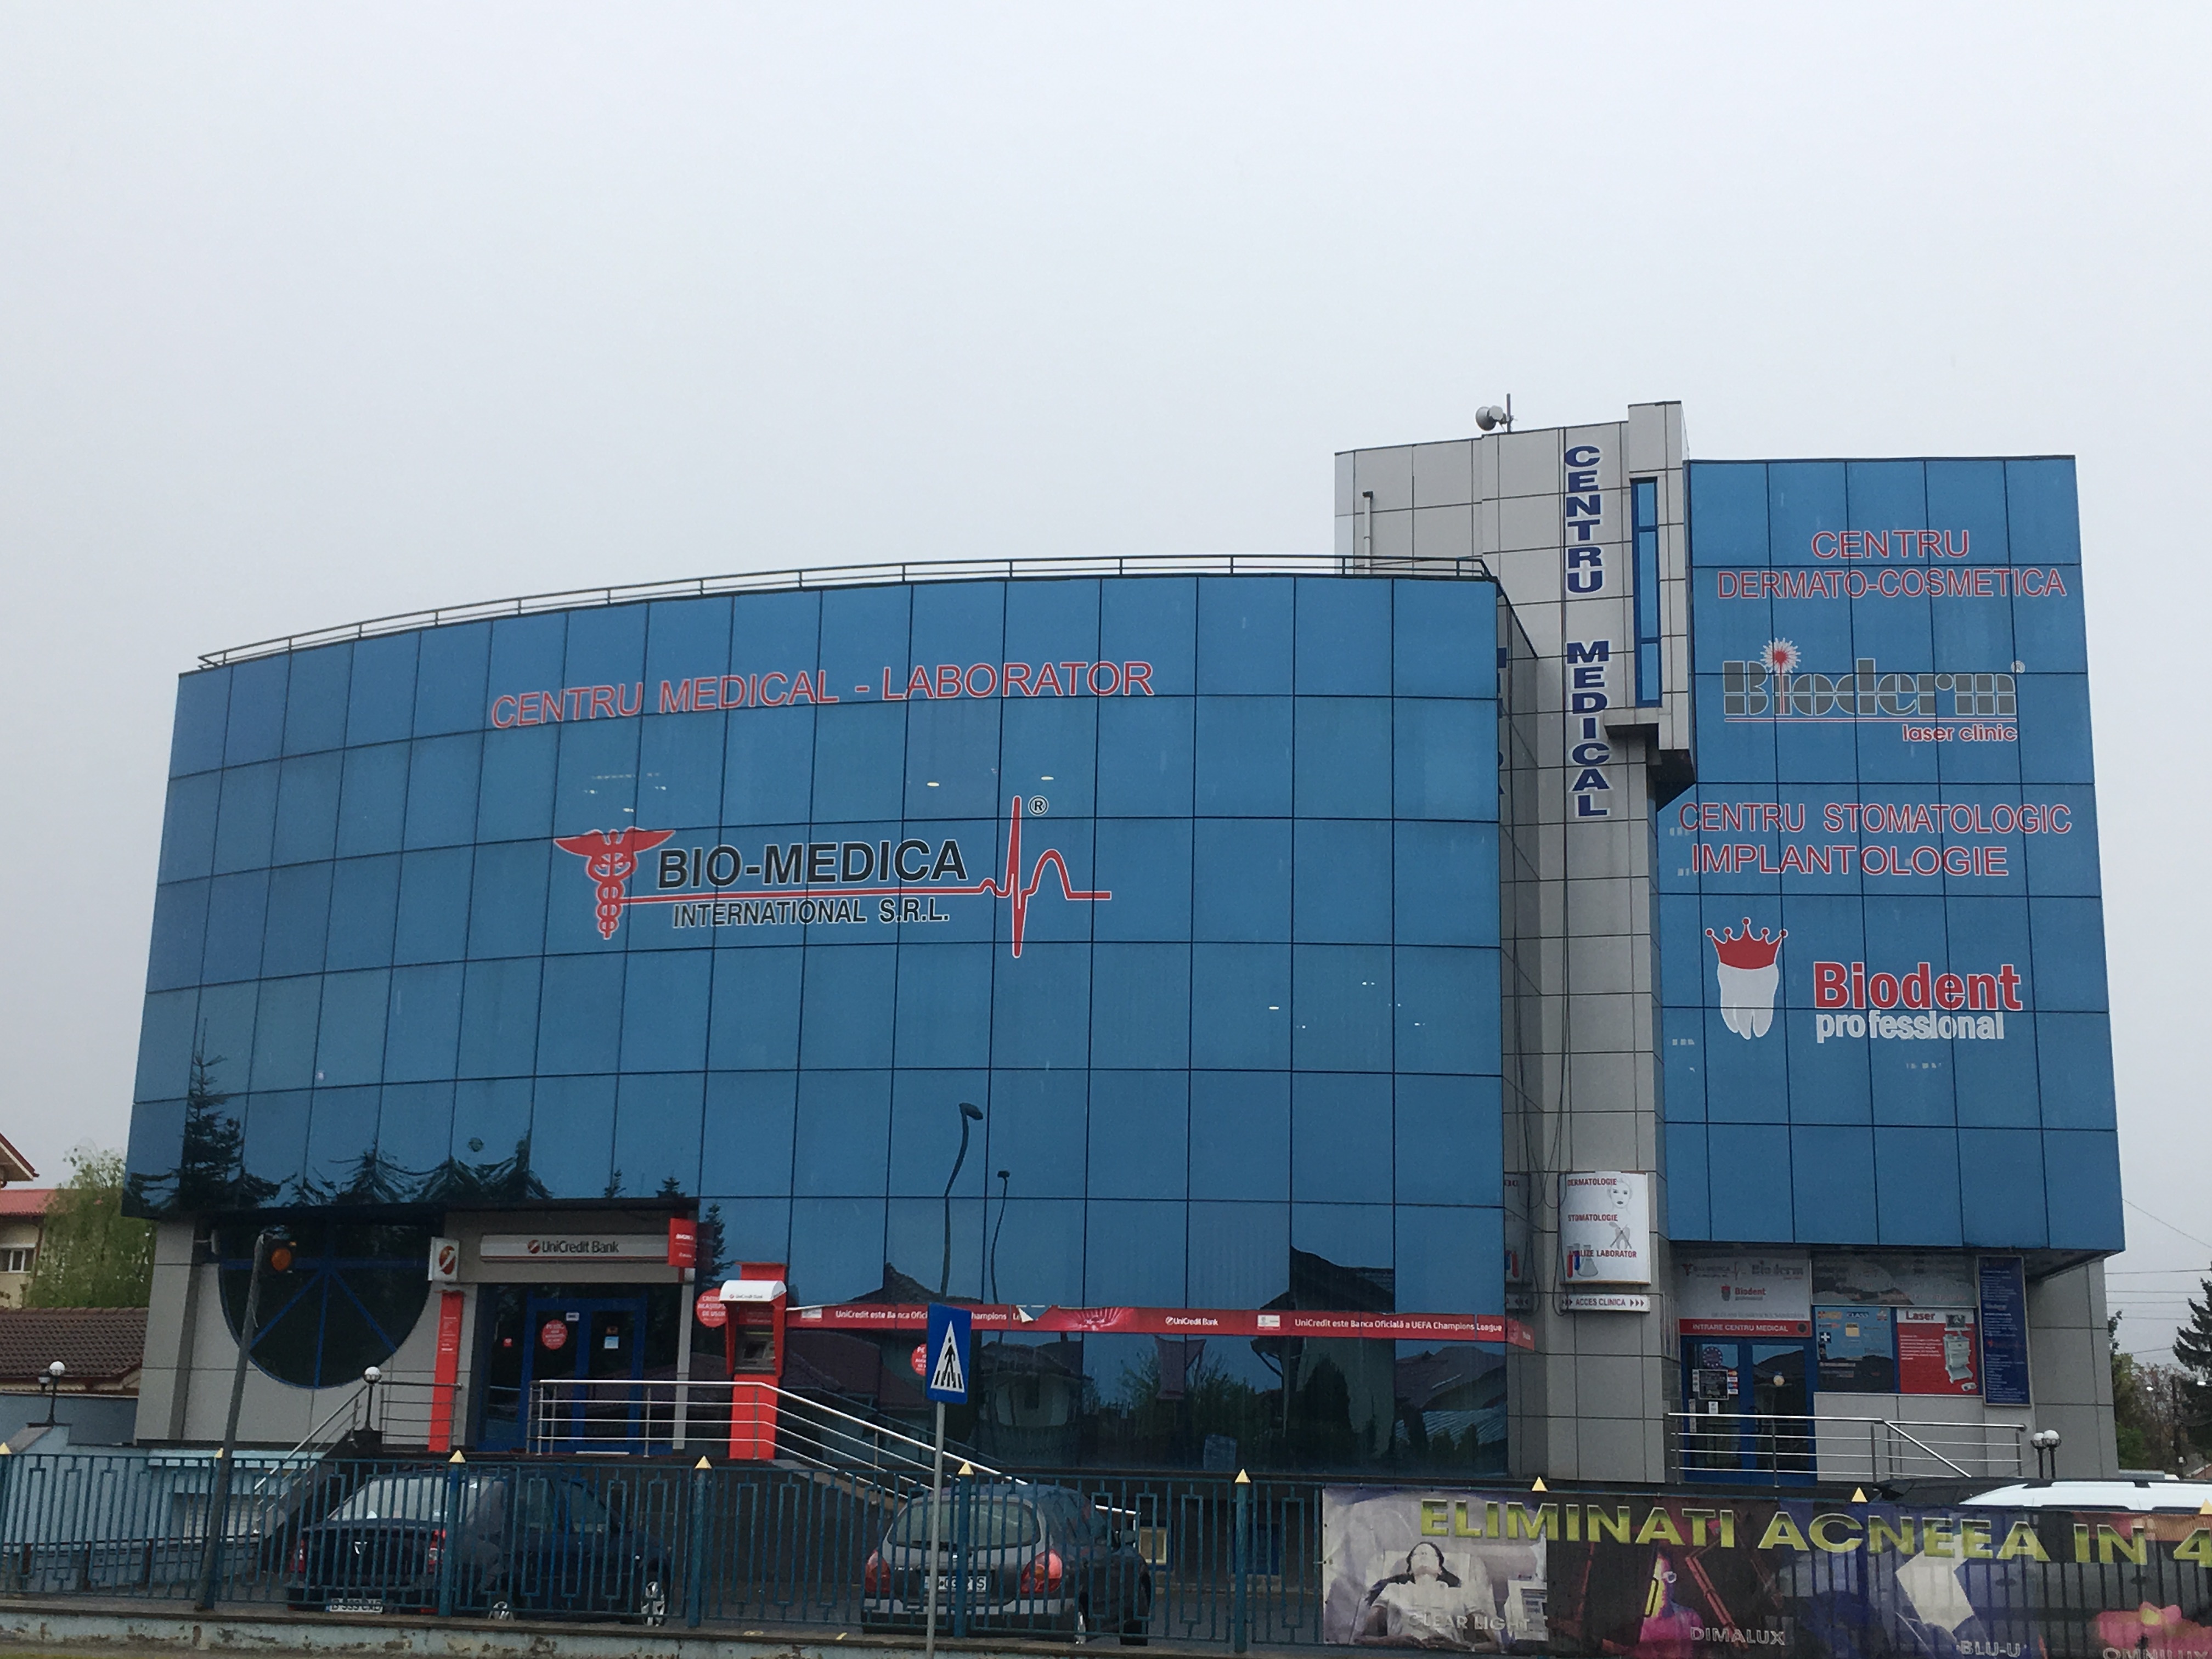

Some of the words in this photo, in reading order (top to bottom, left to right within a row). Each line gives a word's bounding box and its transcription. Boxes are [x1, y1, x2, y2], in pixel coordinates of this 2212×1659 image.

[1564, 445, 1604, 594] CENTRU
[1812, 530, 1970, 558] CENTRU
[1717, 568, 2067, 599] DERMATO-COSMETICA
[492, 682, 643, 729] CENTRU
[659, 669, 839, 714] MEDICAL
[883, 660, 1155, 701] LABORATOR
[1722, 657, 2017, 716] Bioderm
[1565, 640, 1610, 817] MEDICAL
[1902, 724, 1954, 742] laser
[1959, 724, 2018, 742] clinic
[1678, 803, 1806, 832] CENTRU
[1822, 802, 2073, 834] STOMATOLOGIC
[657, 839, 968, 889] BIO-MEDICA
[1691, 844, 2009, 877] IMPLANTOLOGIE
[673, 900, 867, 928] INTERNATIONAL
[878, 897, 949, 923] S.R.L.
[1813, 961, 2023, 1011] Biodent
[1815, 1010, 2005, 1043] professional
[1567, 1178, 1617, 1187] DERMATOLOGIE
[542, 1240, 590, 1253] UniCredit
[592, 1240, 619, 1253] Bank
[1596, 1250, 1637, 1258] LABORATOR
[911, 1311, 927, 1319] Ofici
[971, 1312, 1006, 1321] hampions
[1599, 1299, 1626, 1307] CLINICA
[1905, 1311, 1936, 1321] Laser
[1173, 1317, 1201, 1325] UniCredit
[1295, 1319, 1331, 1327] UniCredit
[1412, 1321, 1432, 1329] UEFA
[1433, 1322, 1475, 1331] Champions
[1476, 1323, 1502, 1332] League
[1421, 1498, 1735, 1549] ELIMINATI
[1757, 1511, 2051, 1562] ACNEEA
[2074, 1523, 2148, 1566] IN
[2173, 1527, 2212, 1568] 4
[1408, 1613, 1468, 1629] CLEAR
[1474, 1616, 1530, 1631] LIGHT
[1690, 1626, 1785, 1646] DIMALUX
[1960, 1640, 2021, 1658] BLU-U
